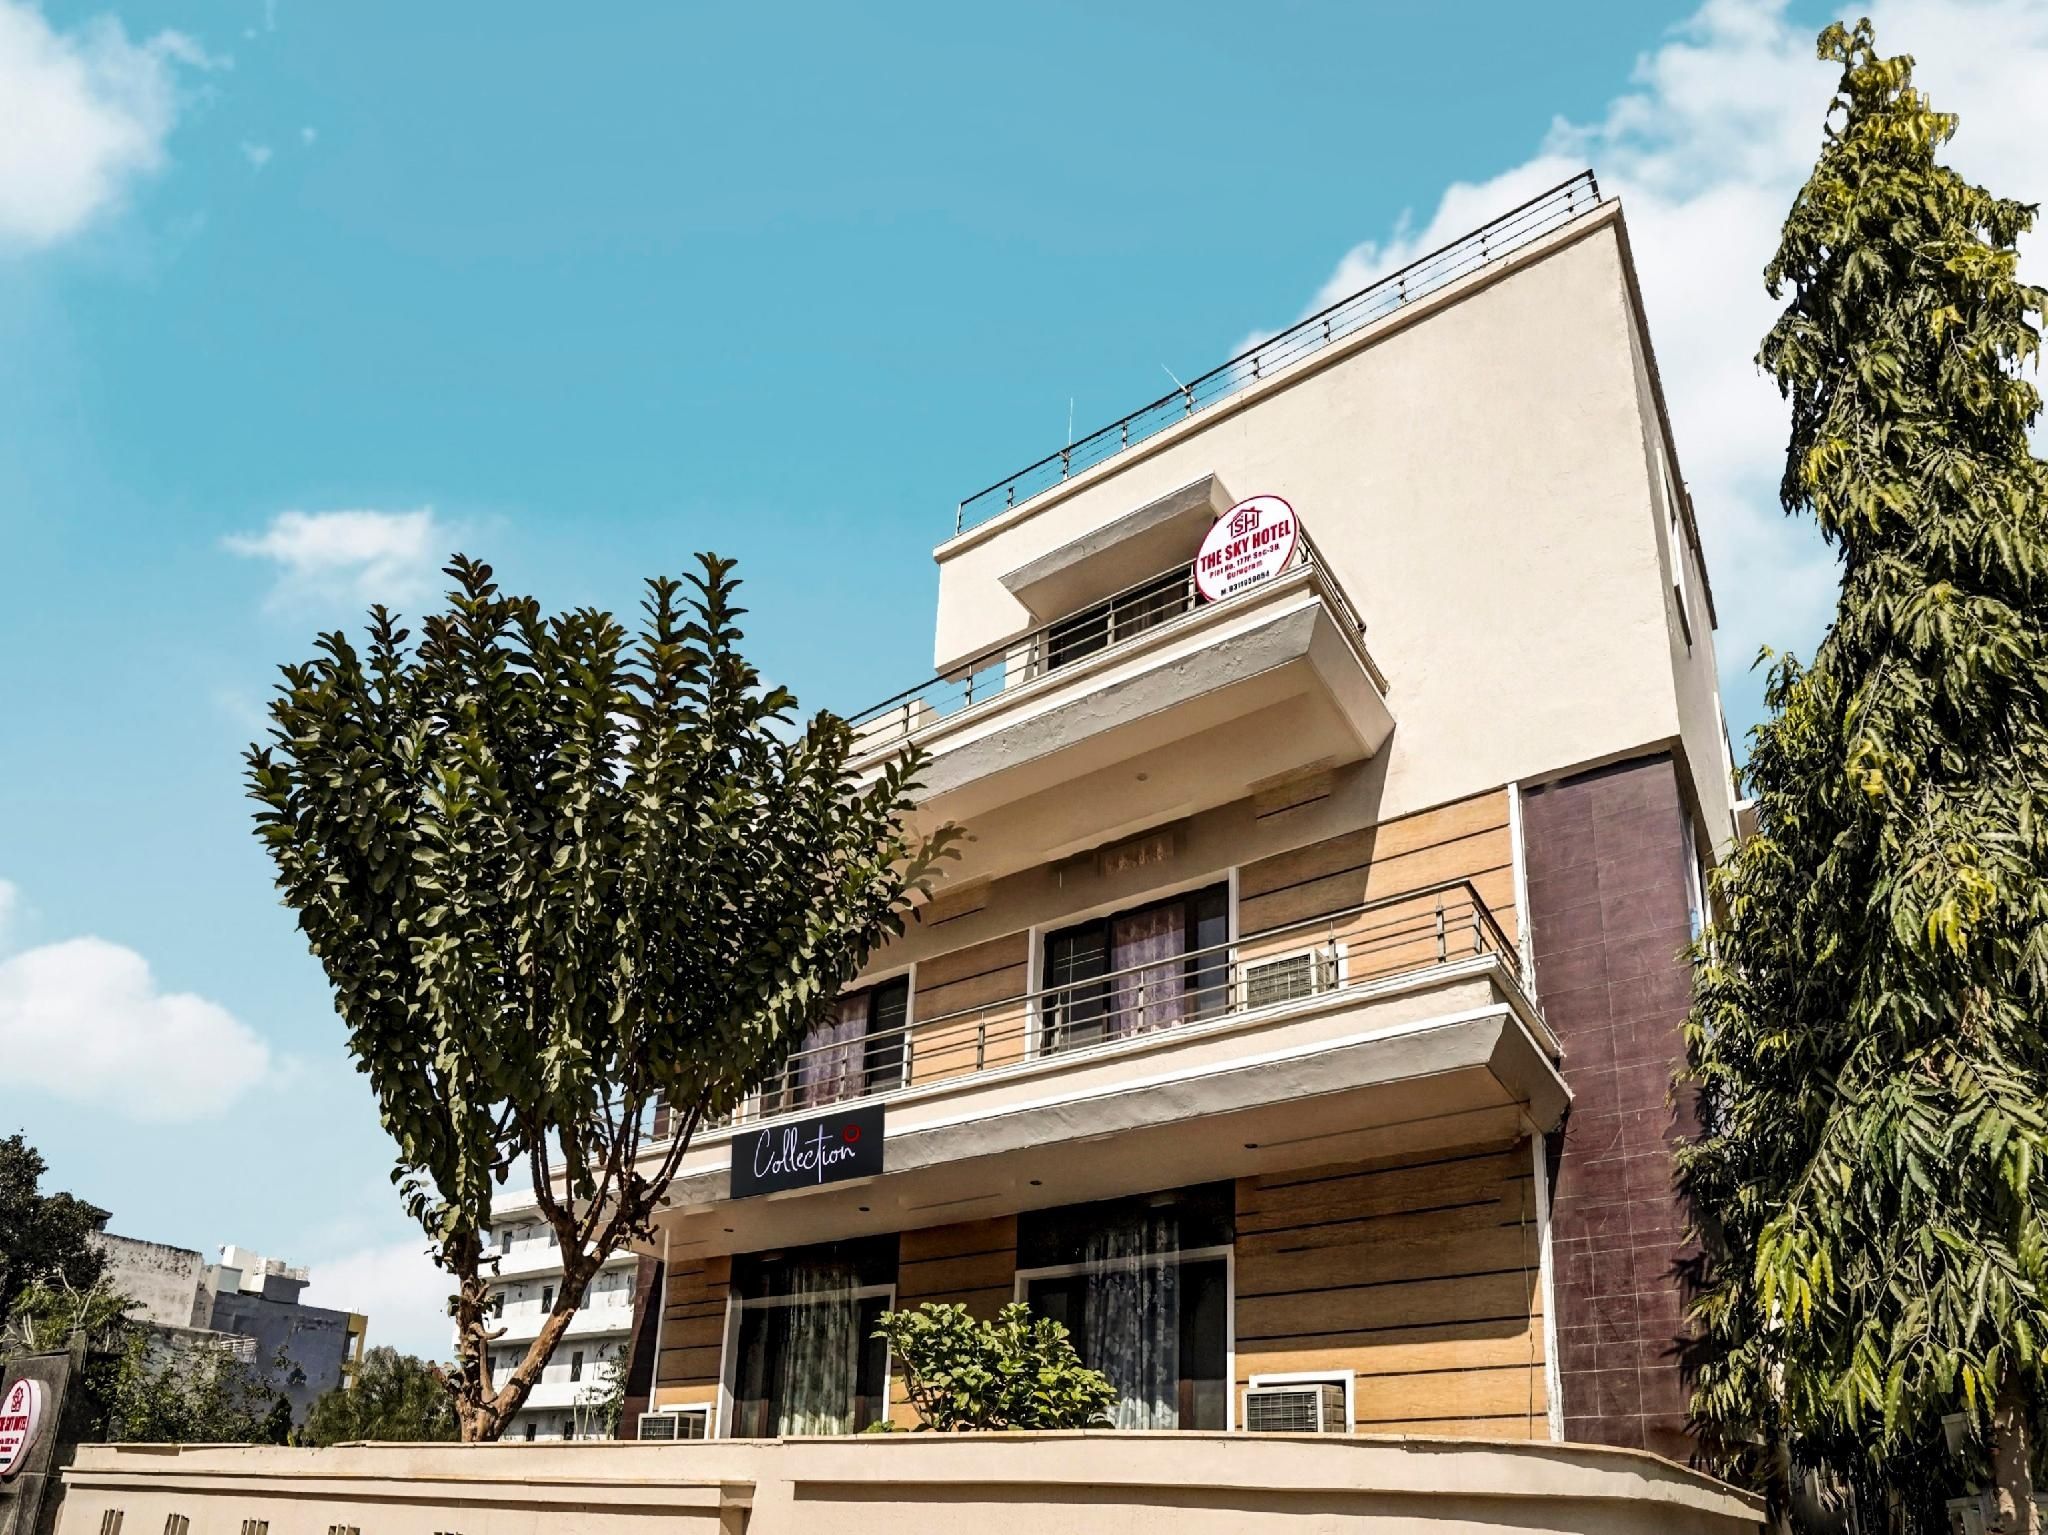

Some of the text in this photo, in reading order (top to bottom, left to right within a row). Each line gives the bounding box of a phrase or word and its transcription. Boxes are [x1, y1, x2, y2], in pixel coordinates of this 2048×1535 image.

[1200, 519, 1291, 572] THE SKY HOTEL
[754, 1124, 856, 1183] Collection
